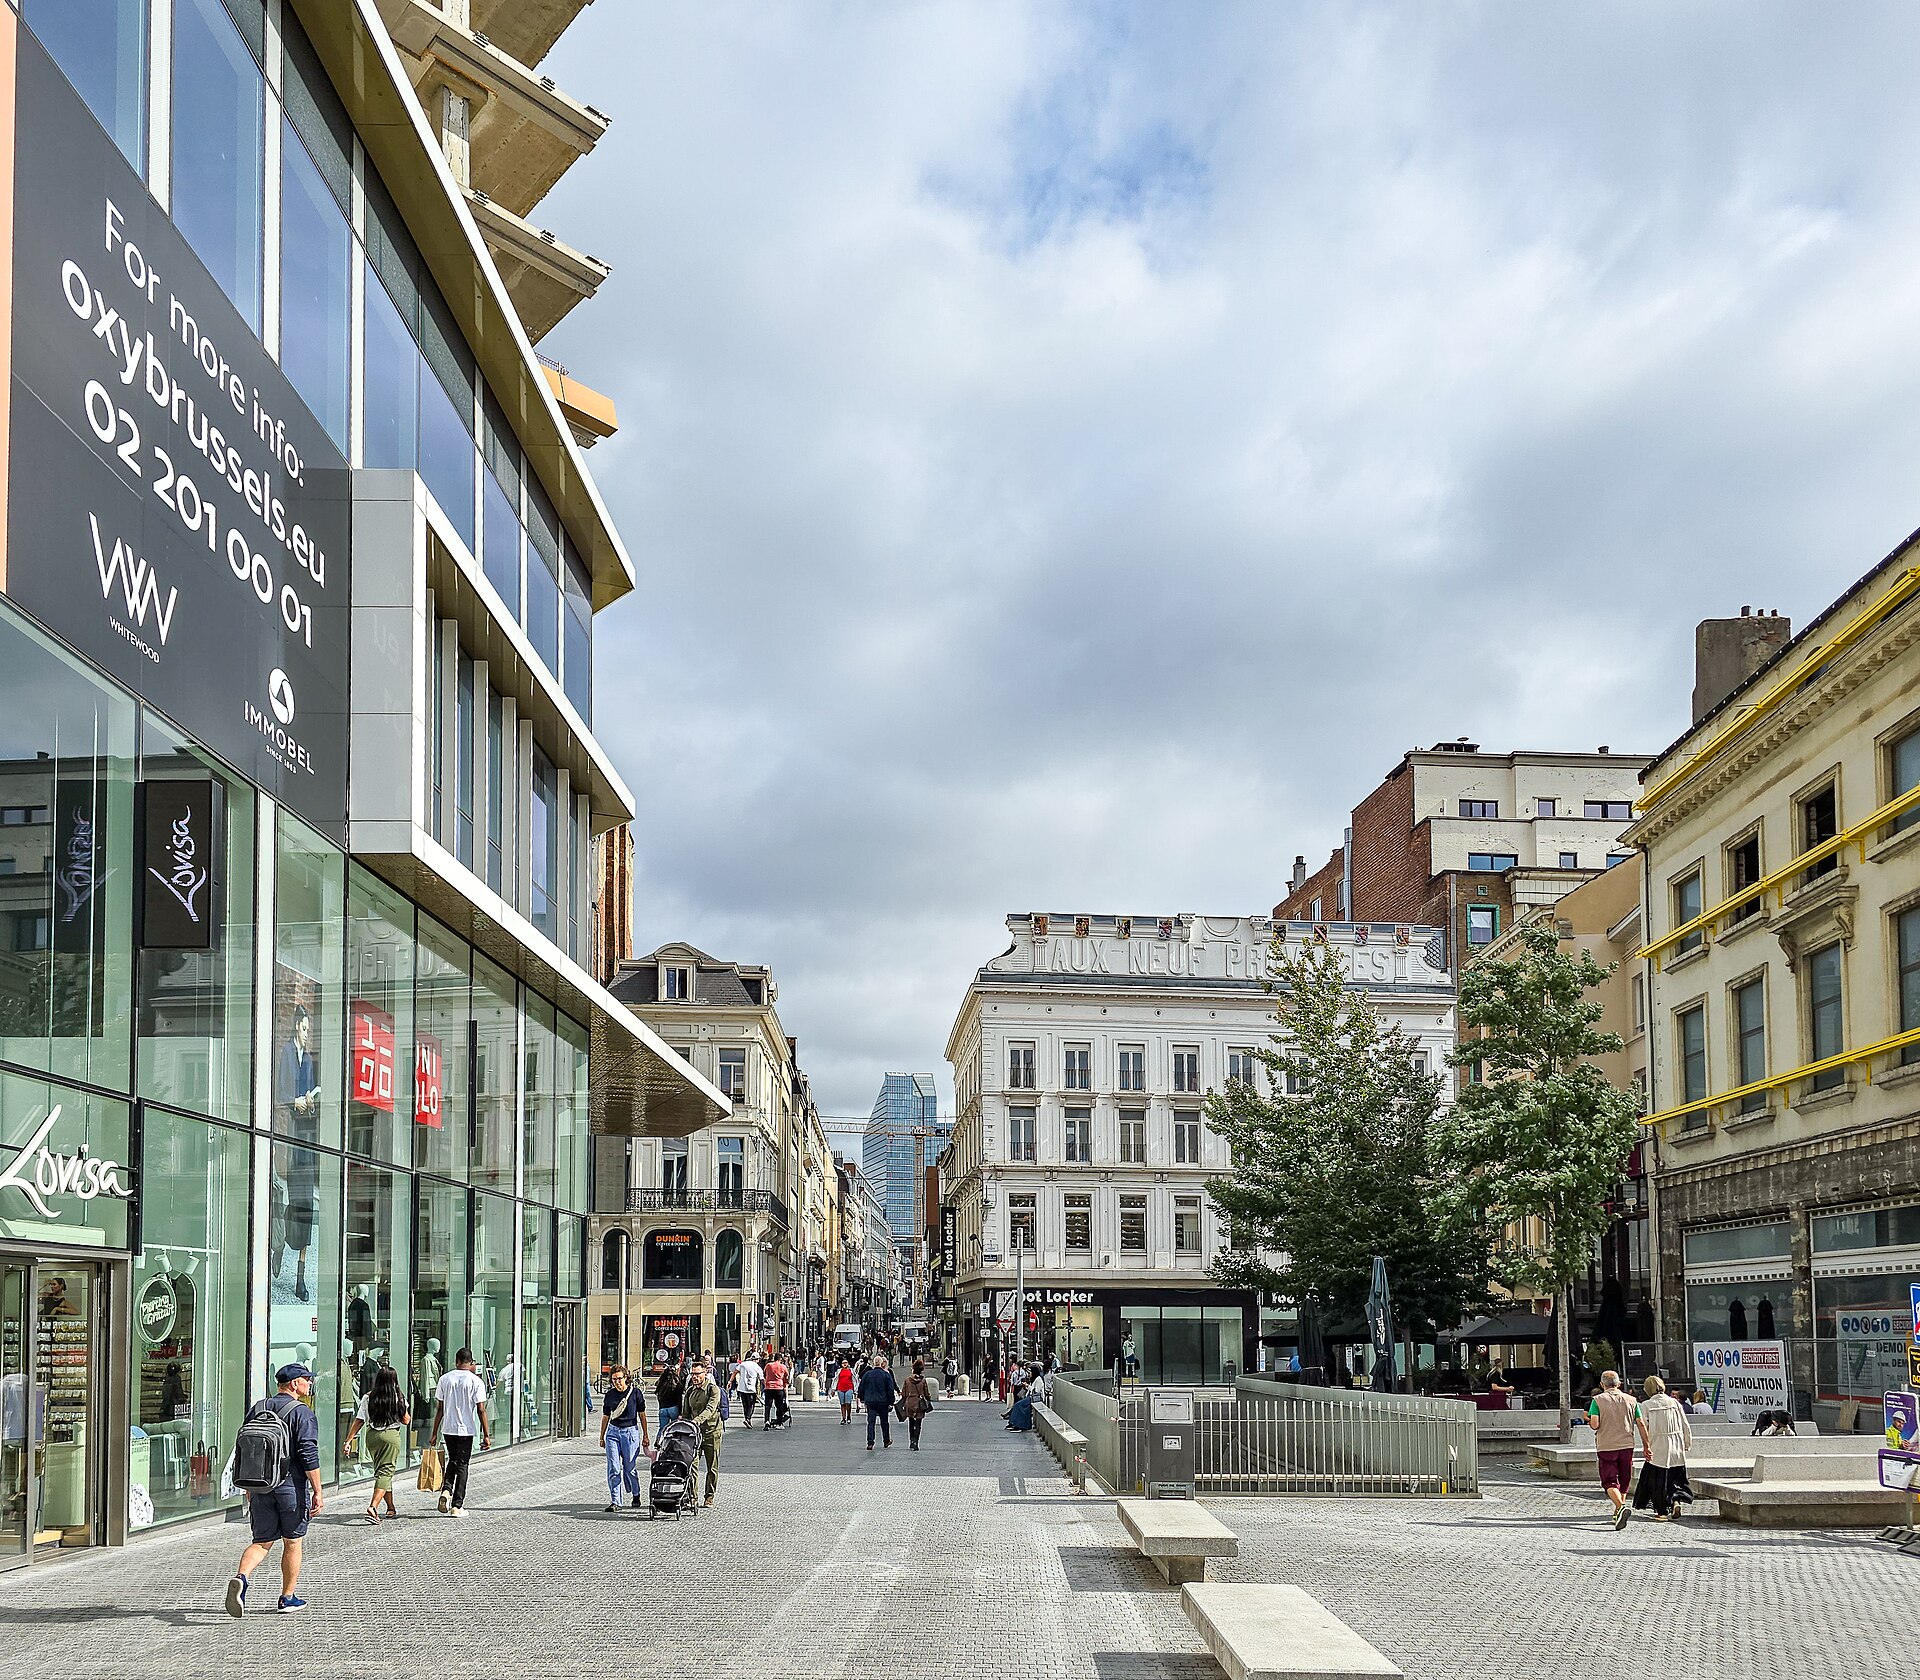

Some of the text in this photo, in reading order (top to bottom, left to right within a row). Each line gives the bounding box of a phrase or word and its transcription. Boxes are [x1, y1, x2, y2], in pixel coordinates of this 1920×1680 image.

[104, 197, 305, 488] For more info:
[60, 258, 326, 589] oxybrussels.eu
[84, 378, 142, 478] 02
[152, 446, 217, 553] 201
[280, 583, 313, 649] 01
[109, 614, 160, 664] WHITEWOOD
[243, 699, 315, 775] IMMOBEL
[148, 805, 207, 923] Lovisa
[1051, 937, 1110, 974] AUX
[1127, 941, 1207, 977] NEUF
[0, 1104, 134, 1218] Lovisa
[943, 1212, 954, 1271] Foot Locker
[1011, 1289, 1094, 1303] ot Locker
[1728, 1376, 1783, 1391] DEMOLITION
[1742, 1353, 1779, 1364] SECURITY FIRST
[1743, 1395, 1764, 1406] DEMO
